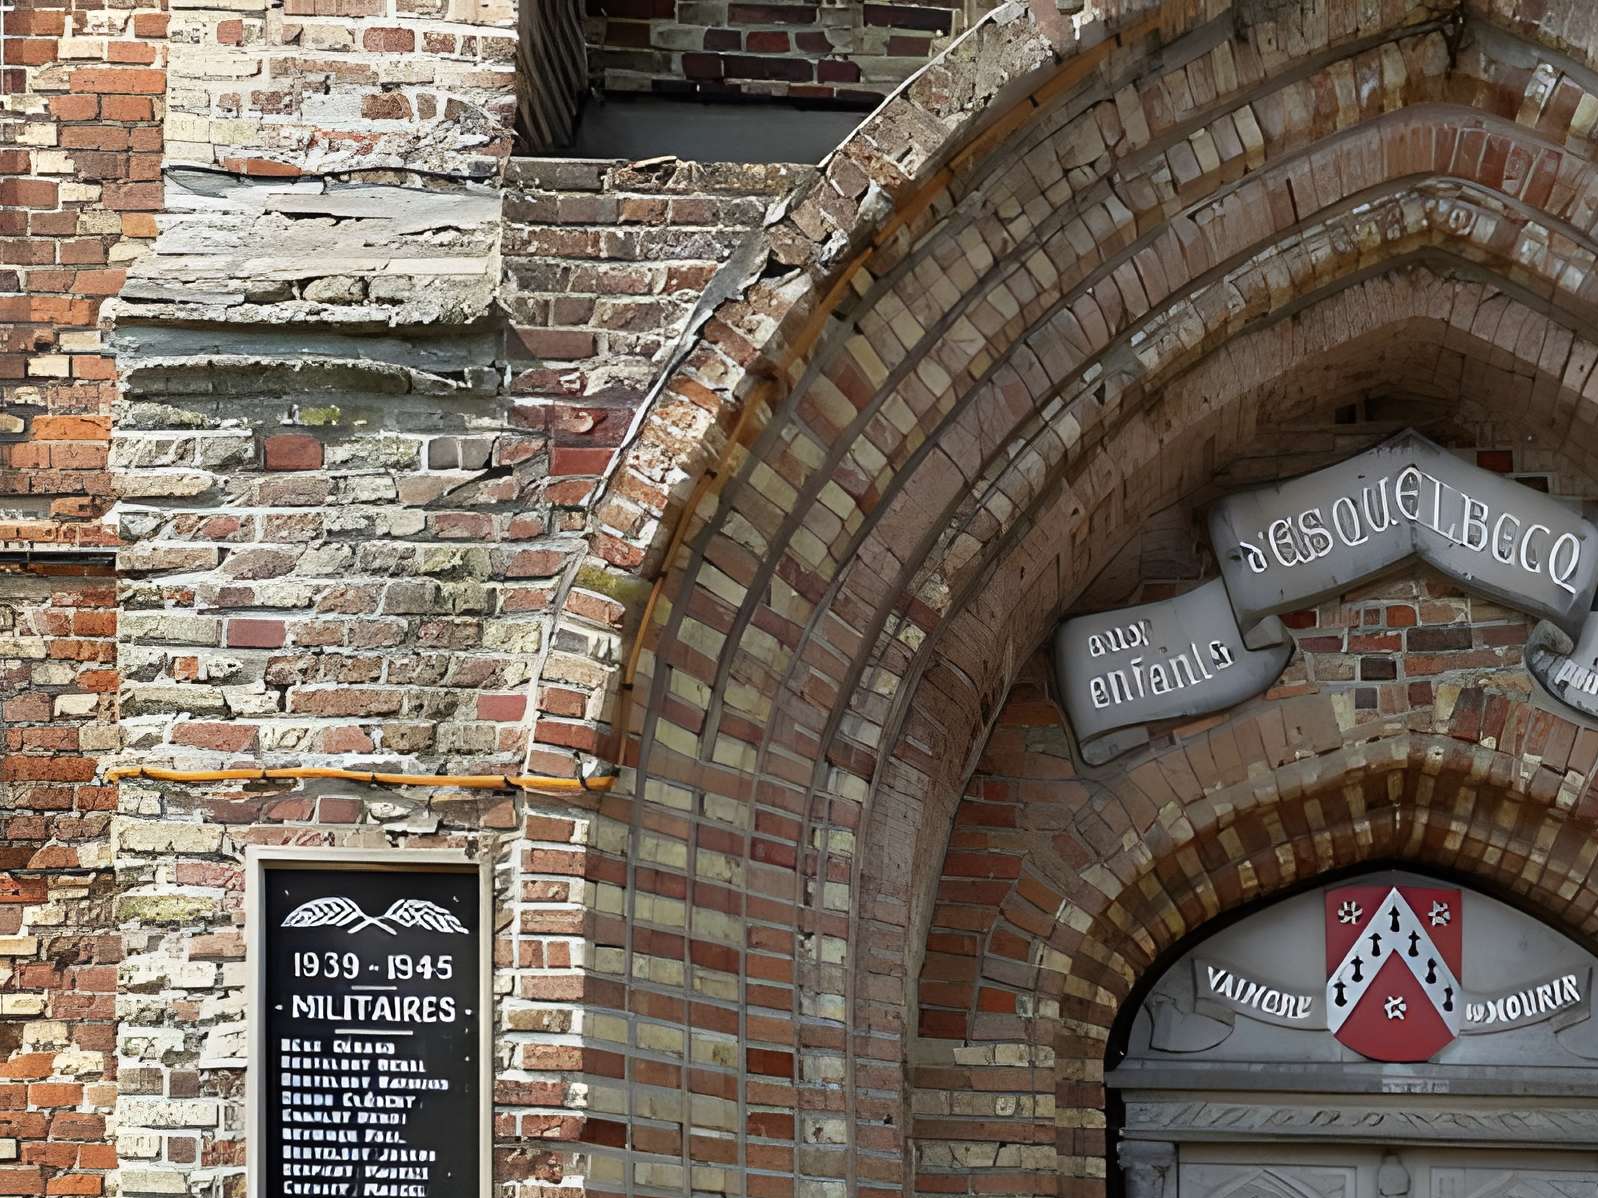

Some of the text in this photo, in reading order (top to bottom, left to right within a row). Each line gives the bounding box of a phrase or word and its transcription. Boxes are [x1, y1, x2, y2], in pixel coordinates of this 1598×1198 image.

[294, 951, 360, 980] 1939
[387, 954, 453, 980] 1945
[292, 994, 456, 1023] MILITAIRES
